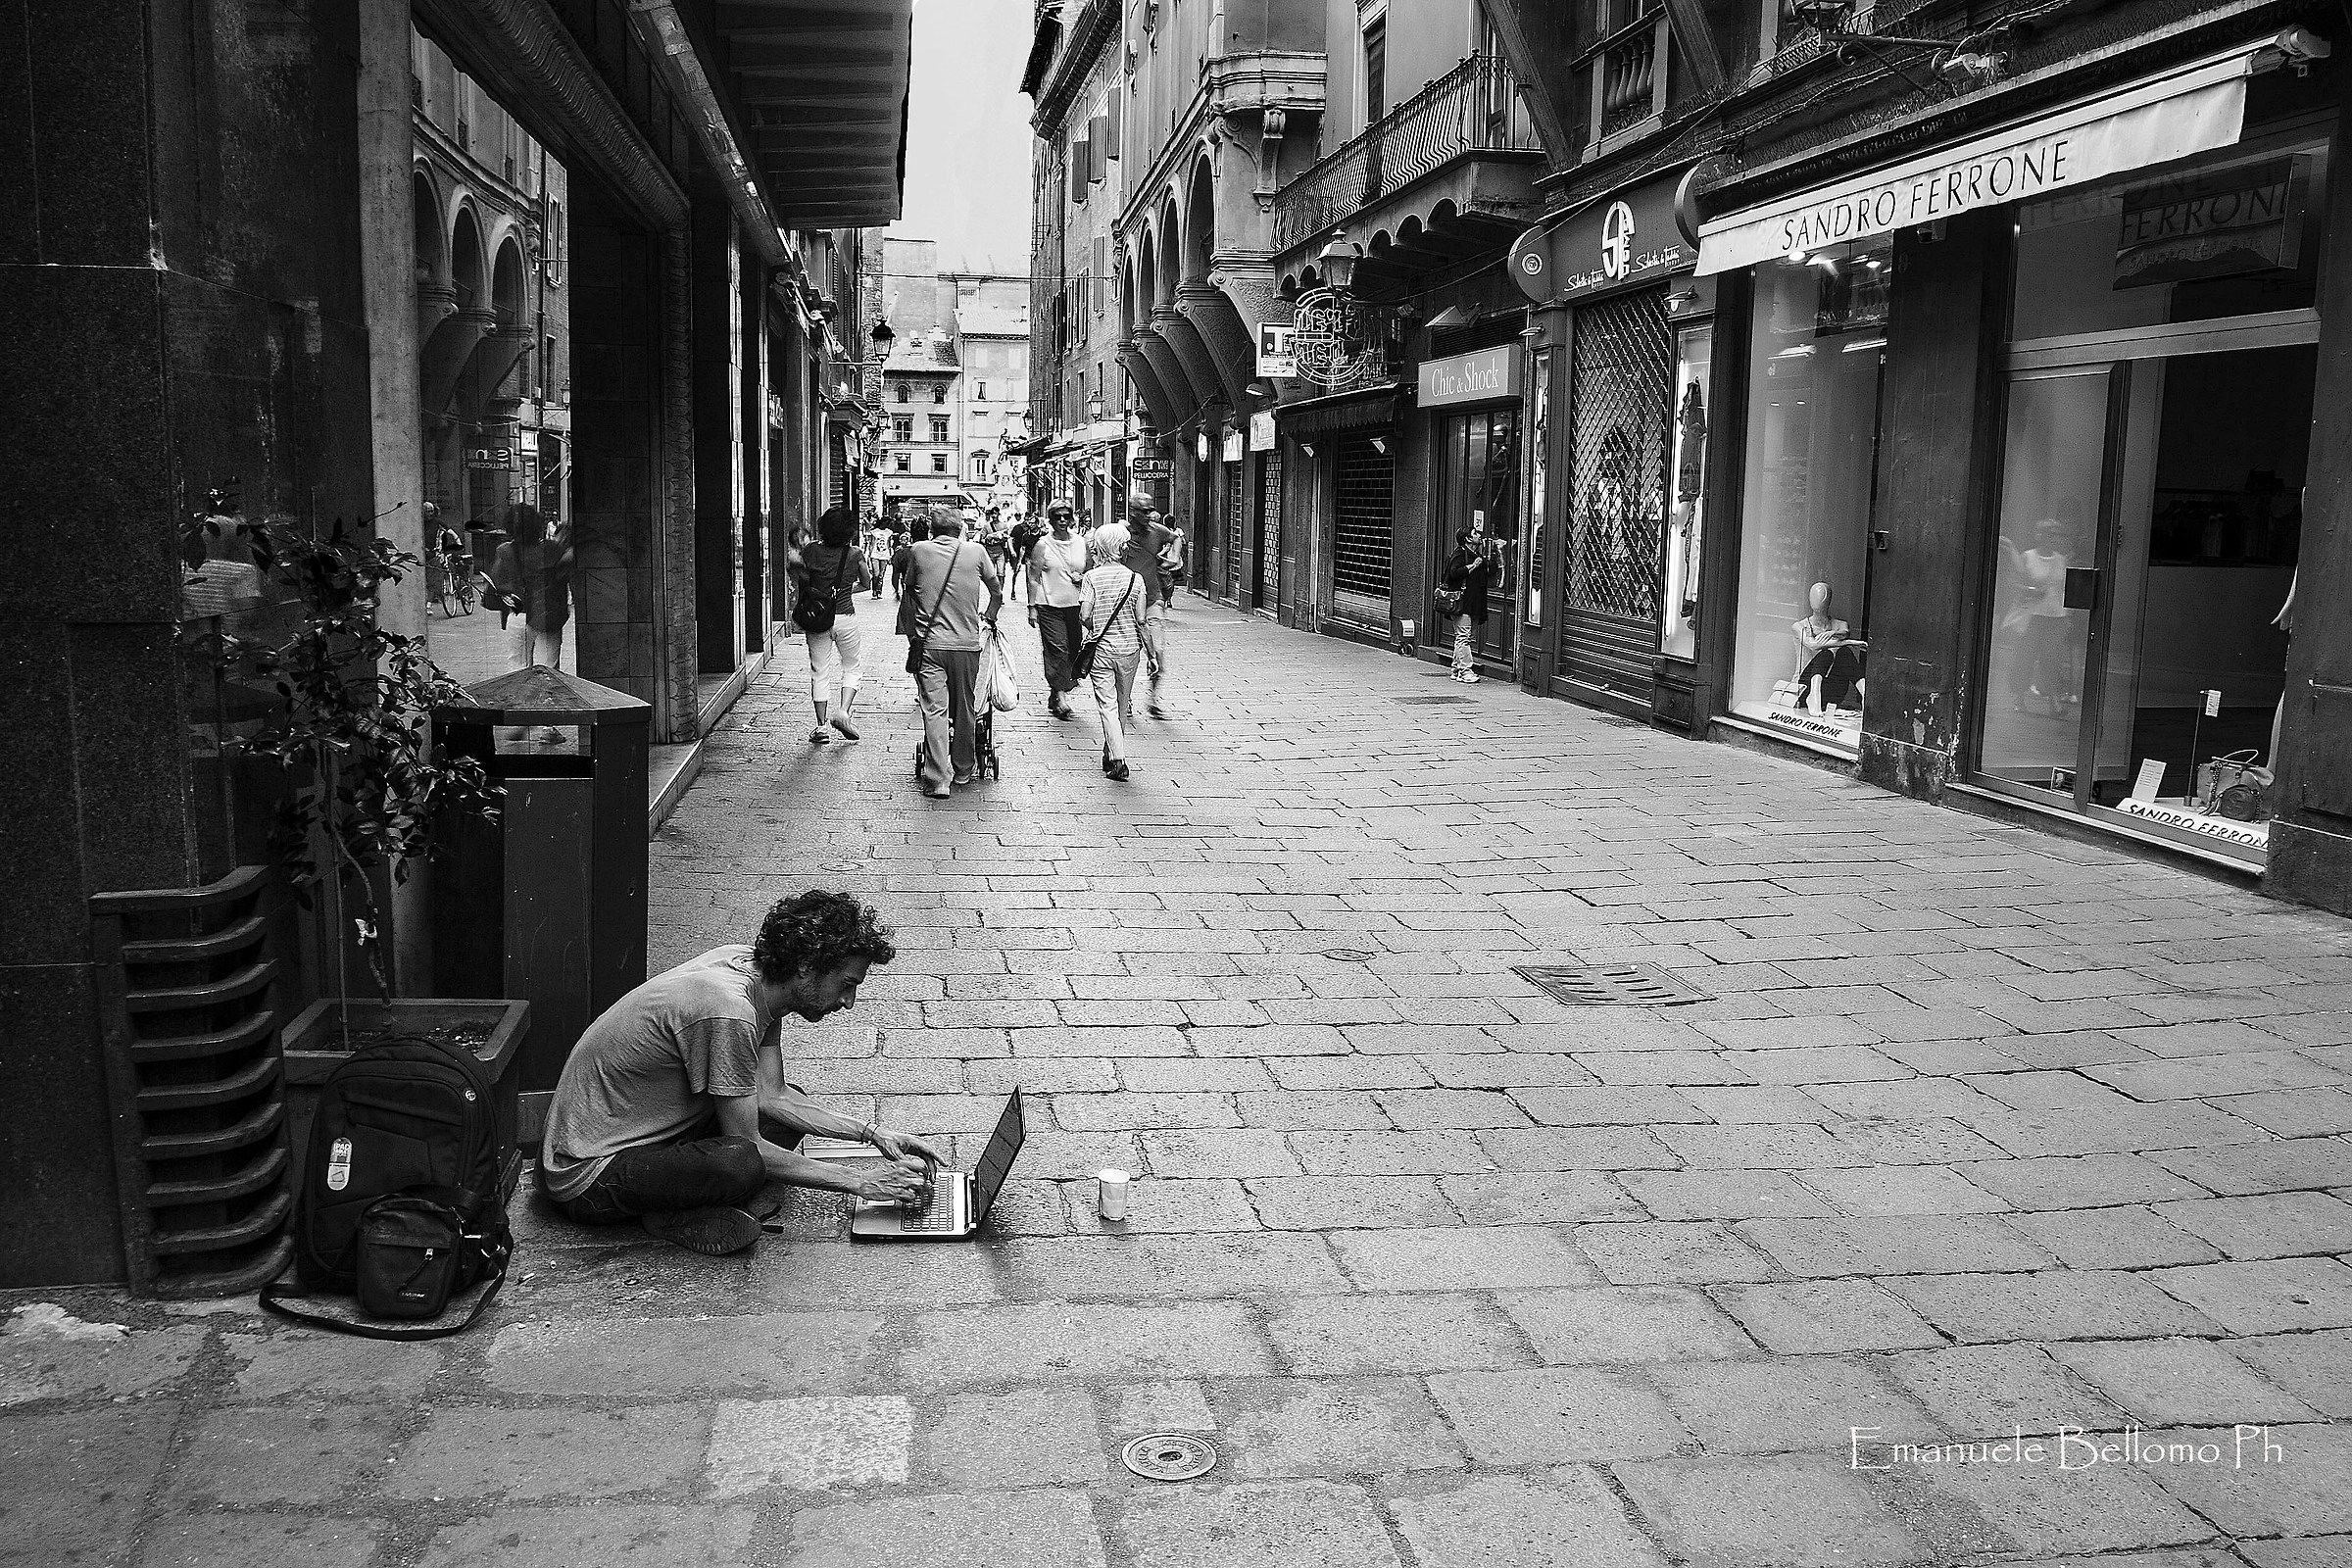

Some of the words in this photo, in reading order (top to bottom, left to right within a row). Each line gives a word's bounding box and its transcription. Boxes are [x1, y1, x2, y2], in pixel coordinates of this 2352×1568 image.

[1782, 187, 1896, 251] SANDRO
[1910, 140, 2070, 220] FERRONE
[1431, 366, 1455, 398] Chic
[1455, 377, 1464, 395] &
[1464, 357, 1499, 393] Shock
[1768, 711, 1803, 727] SANDRO
[1802, 720, 1843, 738] FERRONE
[2129, 804, 2195, 829] SANDRO
